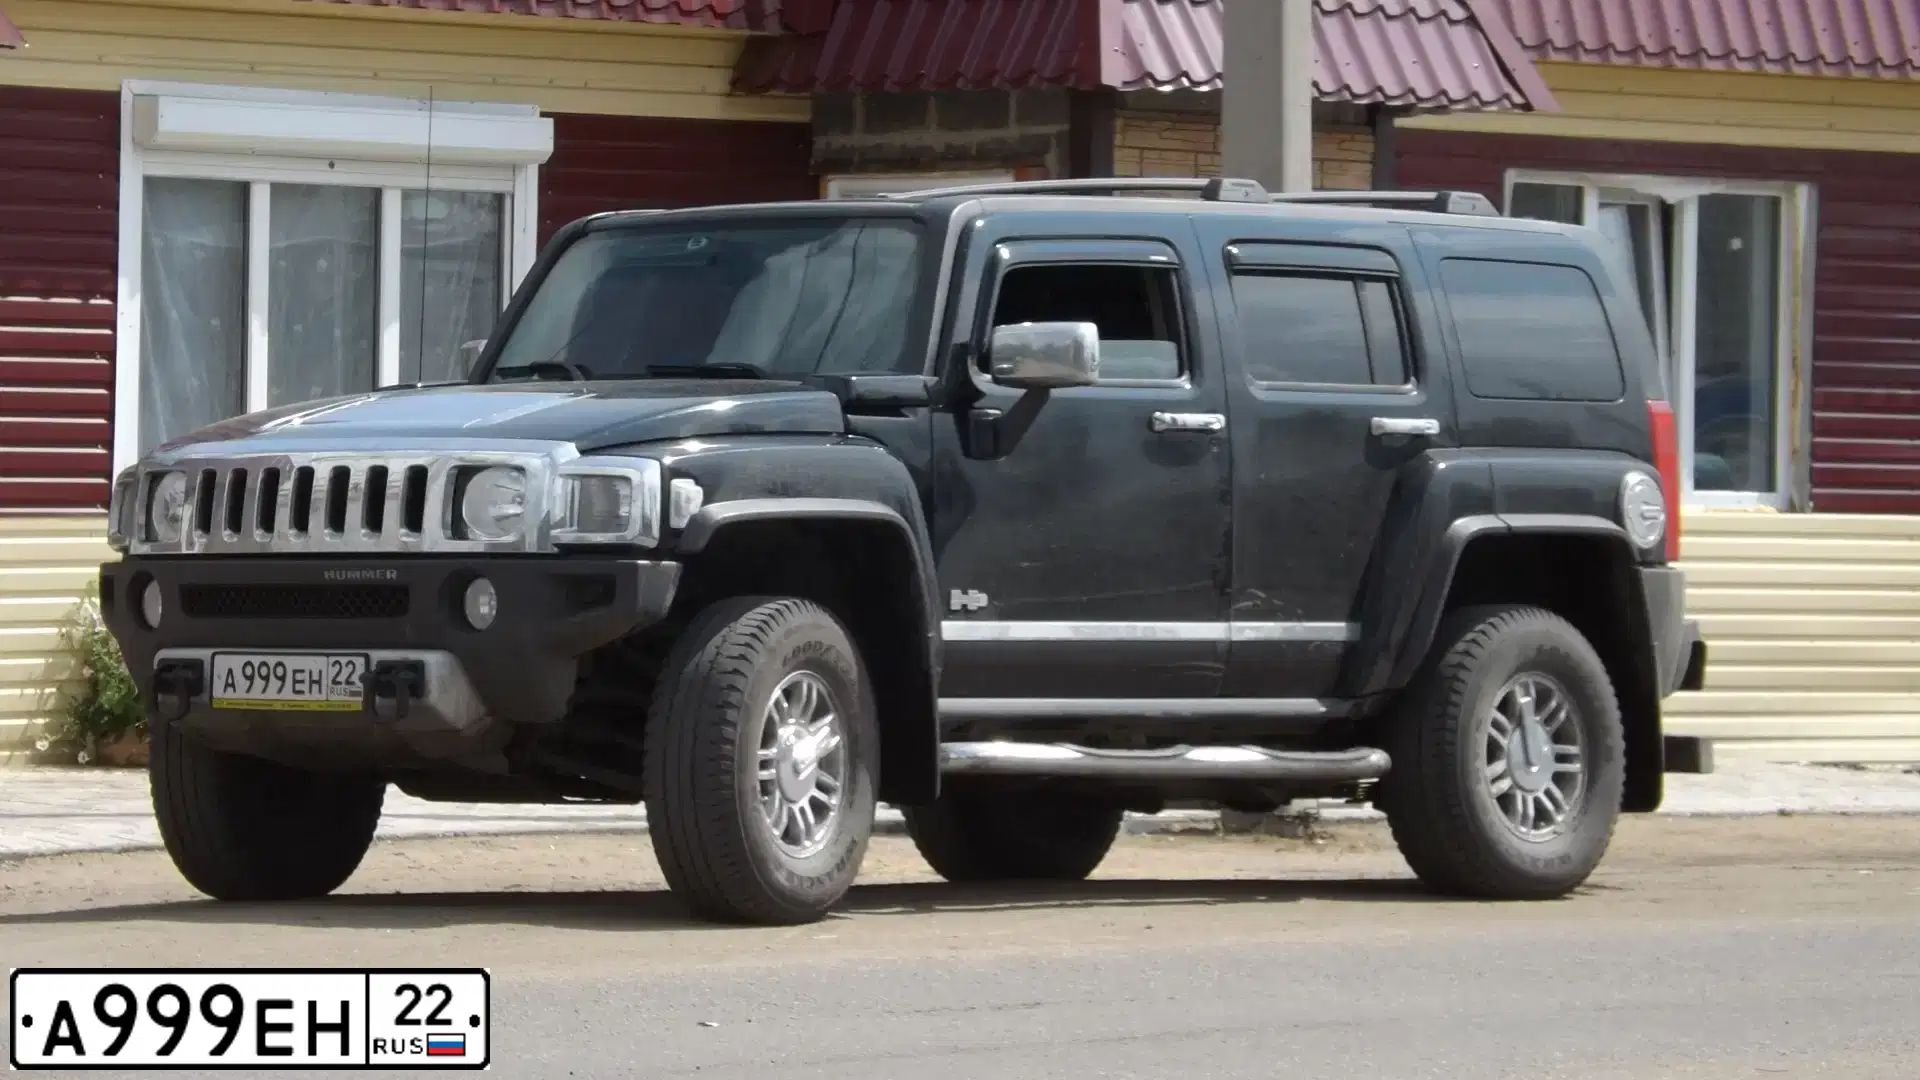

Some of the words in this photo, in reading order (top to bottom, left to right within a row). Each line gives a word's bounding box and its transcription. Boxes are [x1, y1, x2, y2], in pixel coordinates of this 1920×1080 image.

[323, 568, 398, 581] HUMMER
[331, 660, 357, 686] 22
[329, 687, 348, 696] RUS
